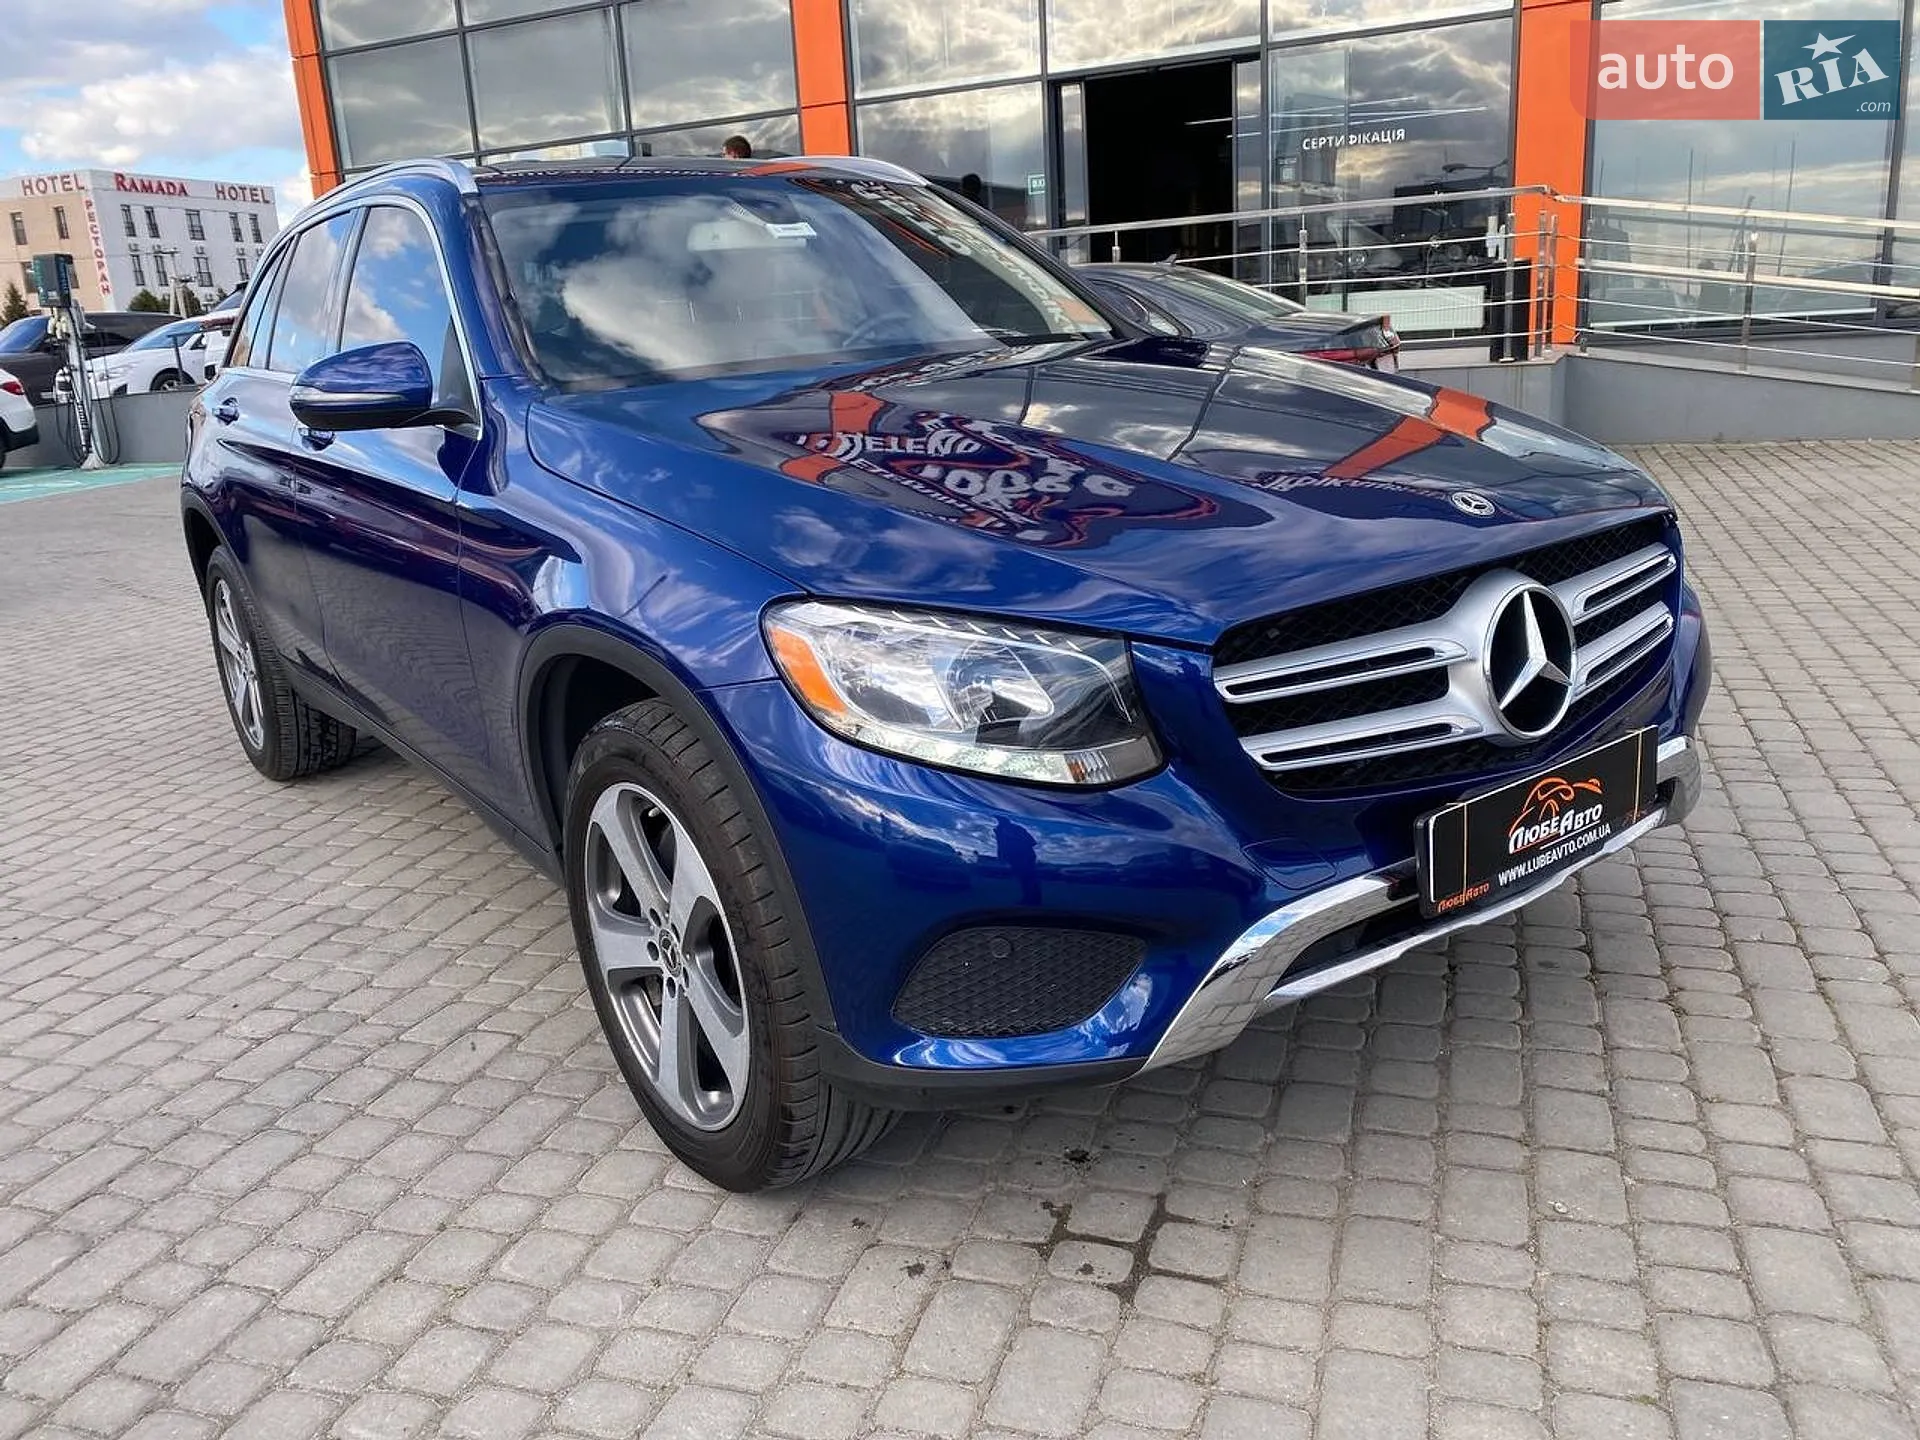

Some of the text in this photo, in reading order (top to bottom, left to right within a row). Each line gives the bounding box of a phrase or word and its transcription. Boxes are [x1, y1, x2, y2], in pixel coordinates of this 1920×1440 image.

[21, 173, 85, 197] HOTEL
[114, 173, 189, 197] RAMADA
[215, 183, 271, 205] HOTEL
[84, 199, 111, 296] РЕСТОРАН
[1498, 824, 1611, 887] WWW.LUBEAVTO.COM.UA
